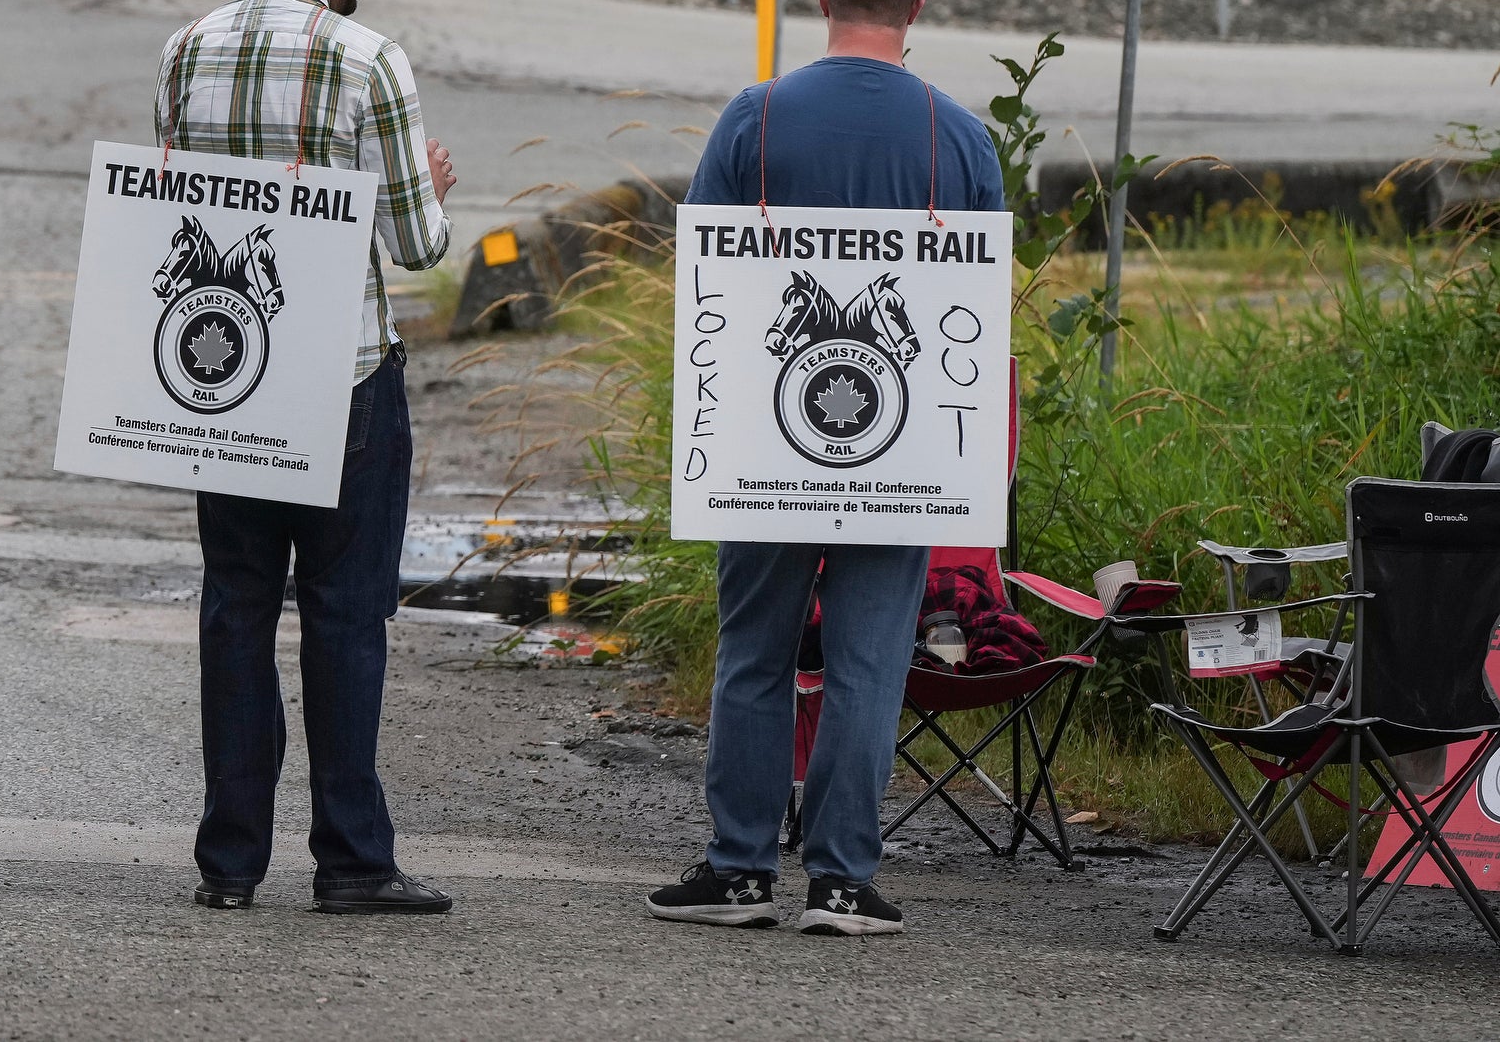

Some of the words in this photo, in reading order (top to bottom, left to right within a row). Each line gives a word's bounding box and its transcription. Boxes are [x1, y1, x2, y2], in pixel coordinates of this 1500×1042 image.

[105, 163, 282, 214] TEAMSTERS
[289, 184, 358, 223] RAIL
[695, 225, 904, 262] TEAMSTERS
[917, 230, 996, 264] RAIL
[178, 294, 252, 325] TEAMSTERS
[683, 264, 726, 481] LOCKED
[798, 348, 885, 376] TEAMSTERS
[192, 388, 219, 402] RAIL
[114, 415, 166, 433] Teamsters
[168, 421, 206, 438] Canada
[209, 427, 229, 441] Rail
[231, 429, 288, 448] Conference
[88, 431, 144, 450] Conférence
[146, 438, 199, 457] ferroviaire
[202, 445, 215, 459] de
[217, 448, 269, 467] Teamsters
[271, 455, 309, 471] Canada
[824, 443, 857, 456] RAIL
[737, 477, 799, 492] Teamsters
[801, 479, 846, 492] Canada
[848, 480, 873, 493] Rail
[875, 481, 942, 495] Conference
[708, 496, 775, 510] Conférence
[777, 498, 840, 512] ferroviaire
[843, 500, 858, 513] de
[861, 501, 923, 515] Teamsters
[925, 502, 970, 516] Canada
[1434, 514, 1469, 522] OUTBOUND
